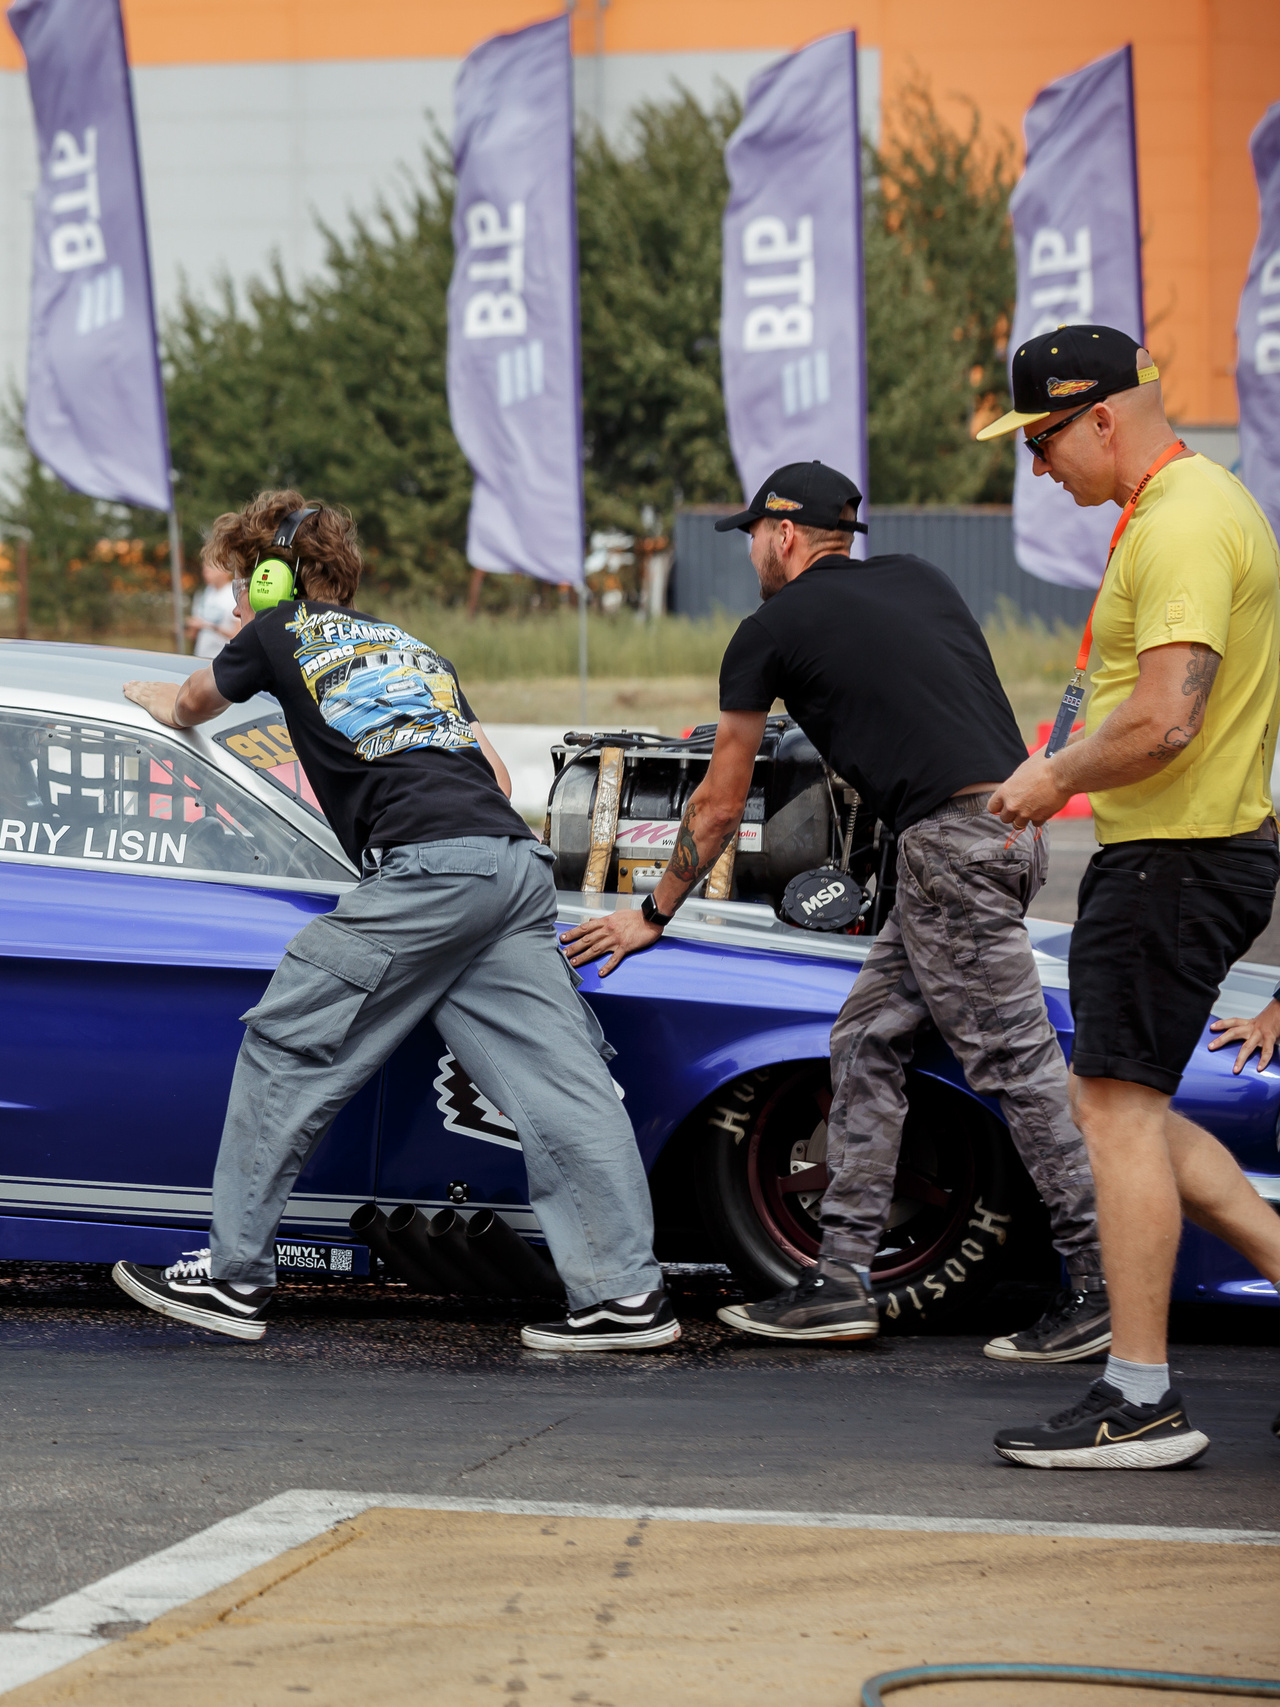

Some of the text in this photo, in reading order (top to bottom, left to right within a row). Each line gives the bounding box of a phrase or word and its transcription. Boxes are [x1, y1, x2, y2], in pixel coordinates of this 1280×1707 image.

[322, 622, 418, 643] FLAMHOL
[82, 828, 188, 864] LISIN
[800, 881, 846, 916] MSD
[278, 1255, 327, 1269] RUSSIA
[868, 1195, 1012, 1320] Hoosie
